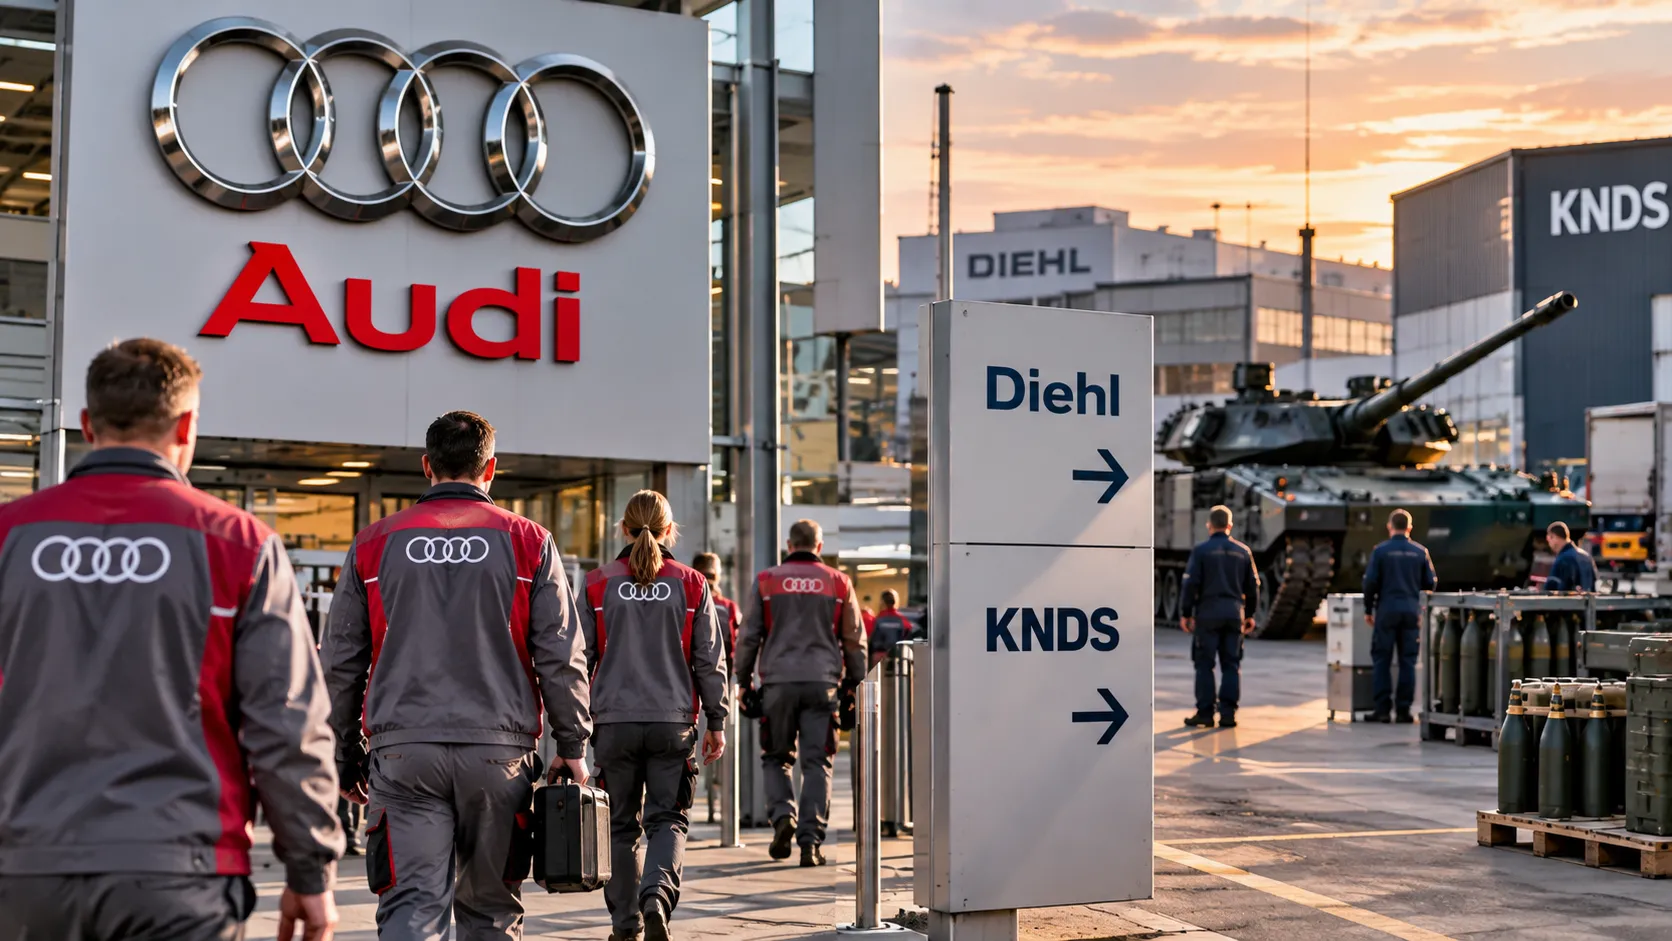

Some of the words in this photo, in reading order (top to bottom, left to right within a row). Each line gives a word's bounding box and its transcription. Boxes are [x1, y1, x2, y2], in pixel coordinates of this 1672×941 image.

[1550, 181, 1670, 236] KNDS
[968, 247, 1092, 279] DIEHL
[199, 241, 581, 362] Audi
[986, 365, 1120, 417] Diehl
[986, 606, 1120, 653] KNDS
